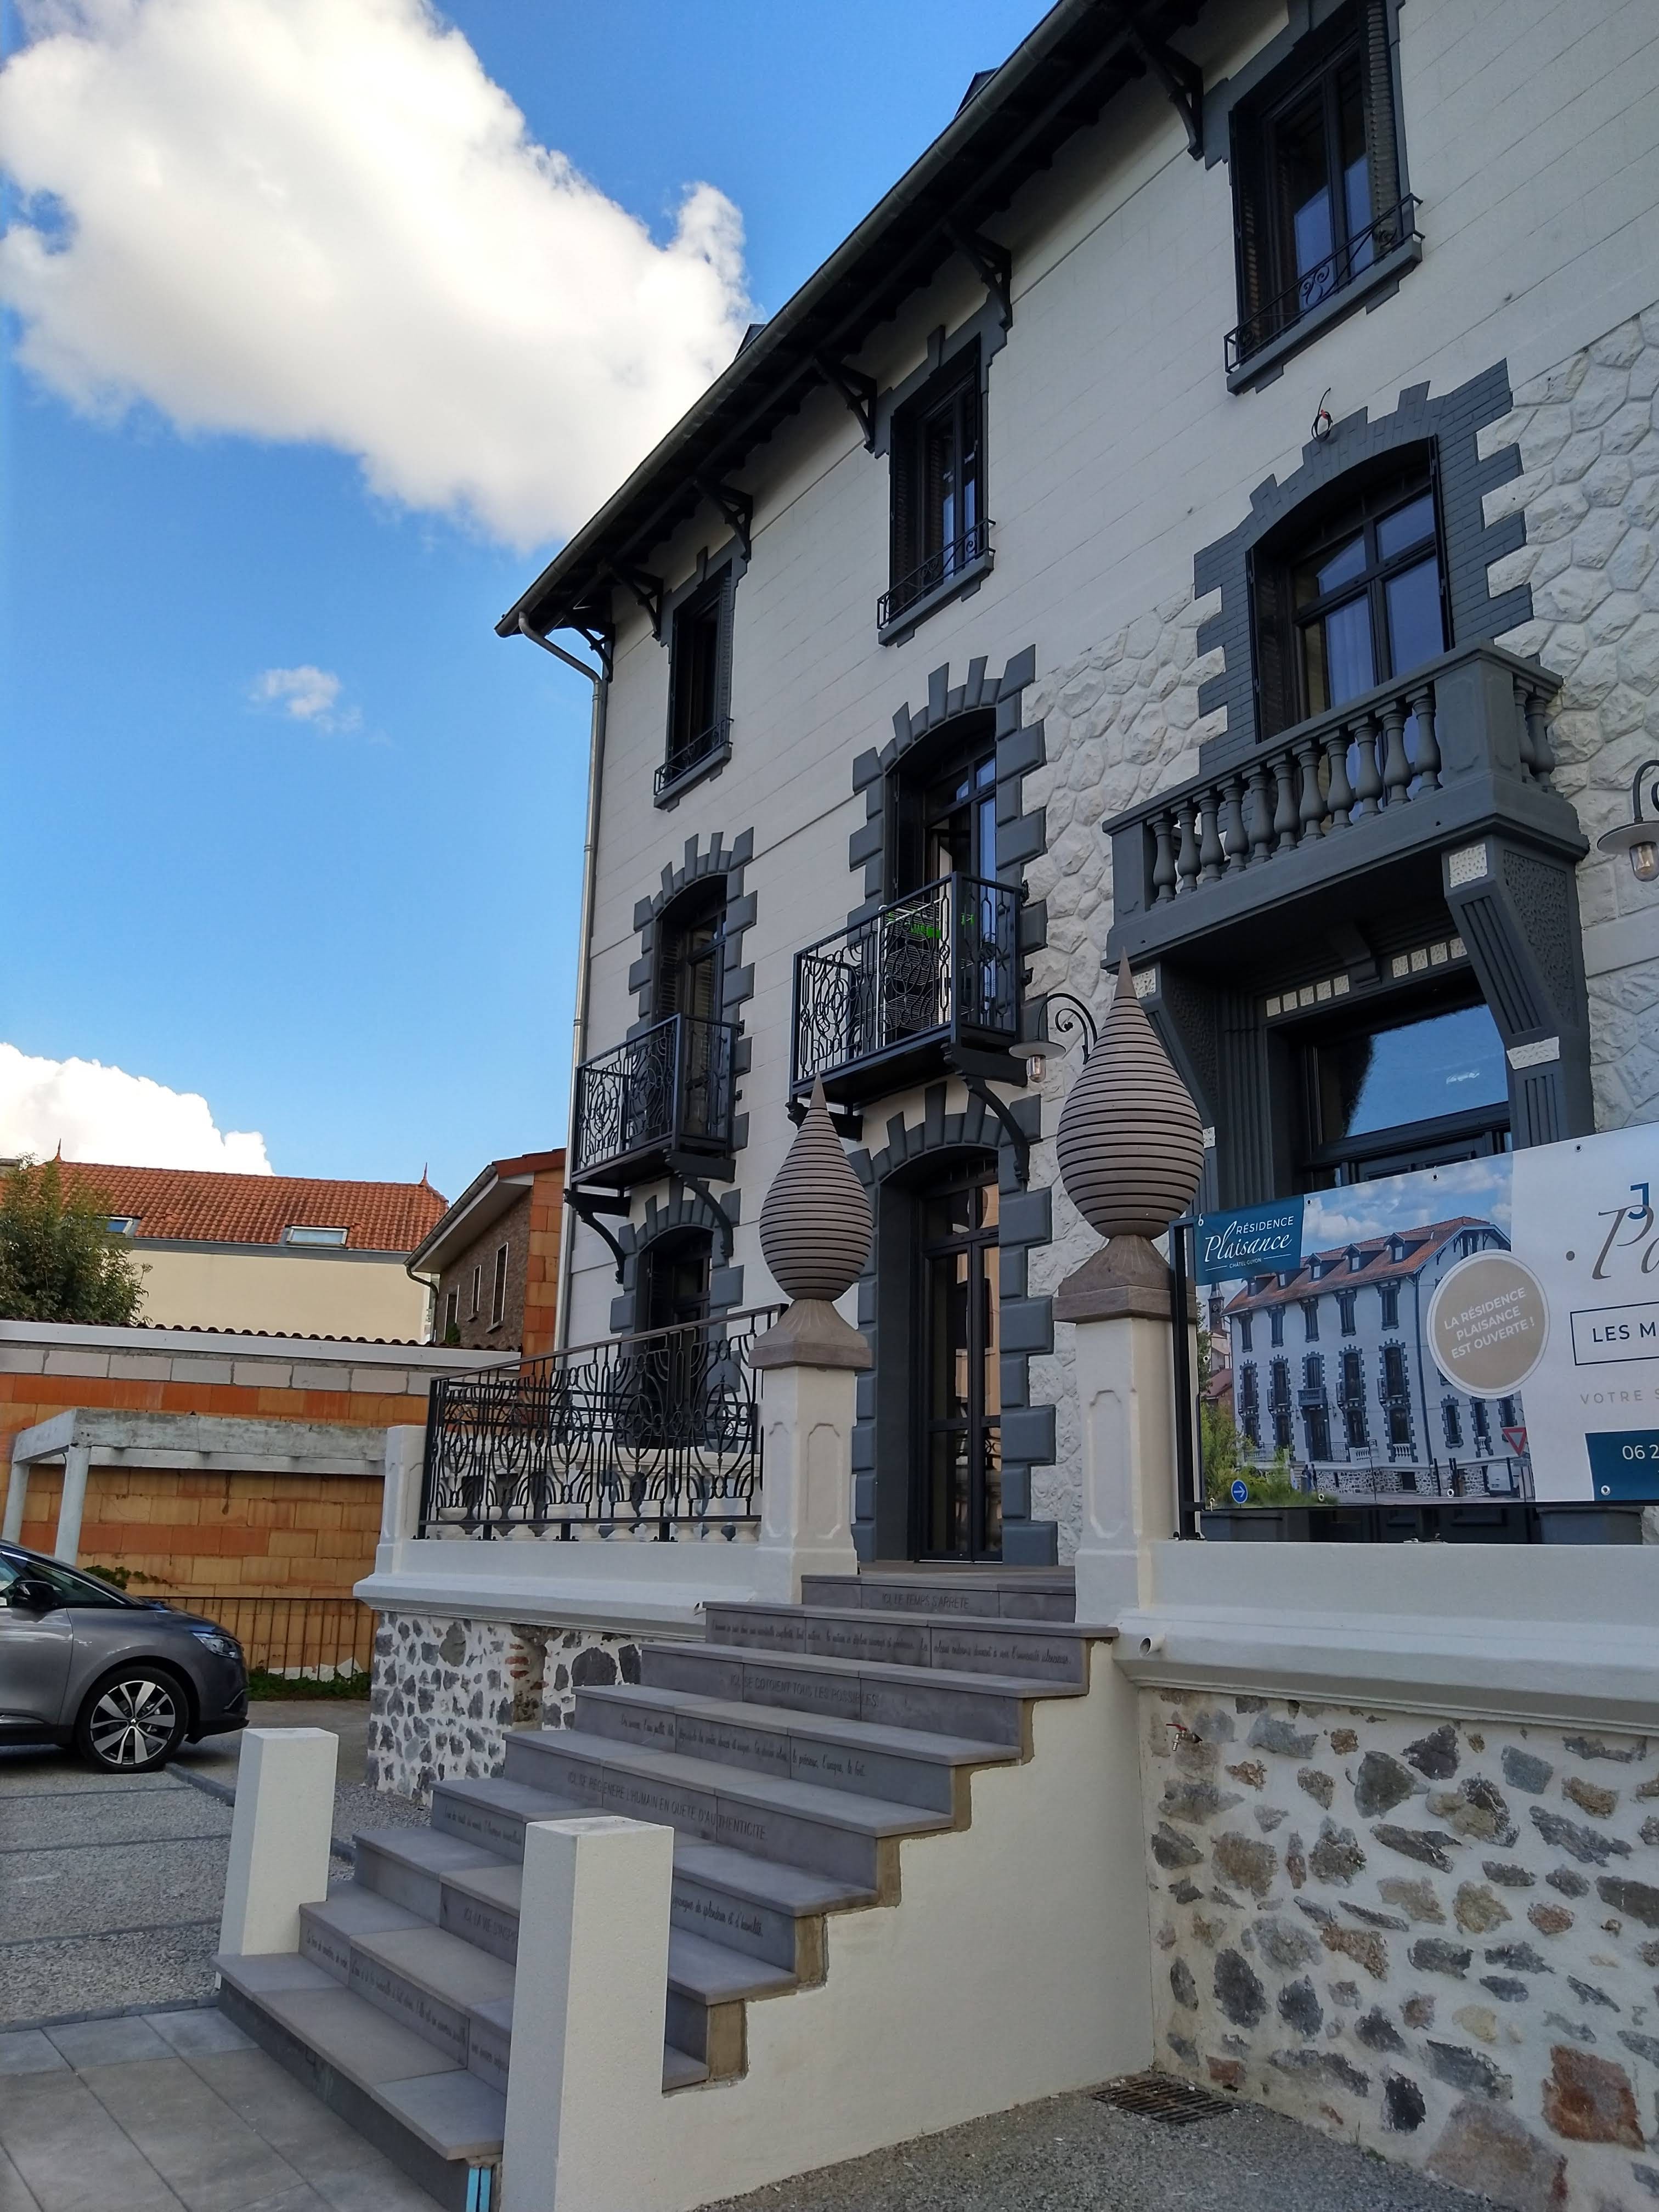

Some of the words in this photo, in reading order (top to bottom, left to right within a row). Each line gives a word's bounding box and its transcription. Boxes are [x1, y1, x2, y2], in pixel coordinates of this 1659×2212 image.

[1236, 1216, 1294, 1235] RÉSIDENCE
[1204, 1220, 1293, 1262] Plaisance
[1229, 1257, 1262, 1268] CHÂTEL-GUYON
[1444, 1317, 1460, 1330] LA
[1460, 1287, 1526, 1323] RÉSIDENCE
[1456, 1306, 1521, 1341] PLAISANCE
[1451, 1342, 1471, 1359] EST
[1474, 1319, 1529, 1349] OUVERTE
[1593, 1324, 1630, 1343] LES
[1580, 1390, 1643, 1404] VOTRE
[1622, 1445, 1645, 1460] 06
[659, 1797, 669, 1813] EN
